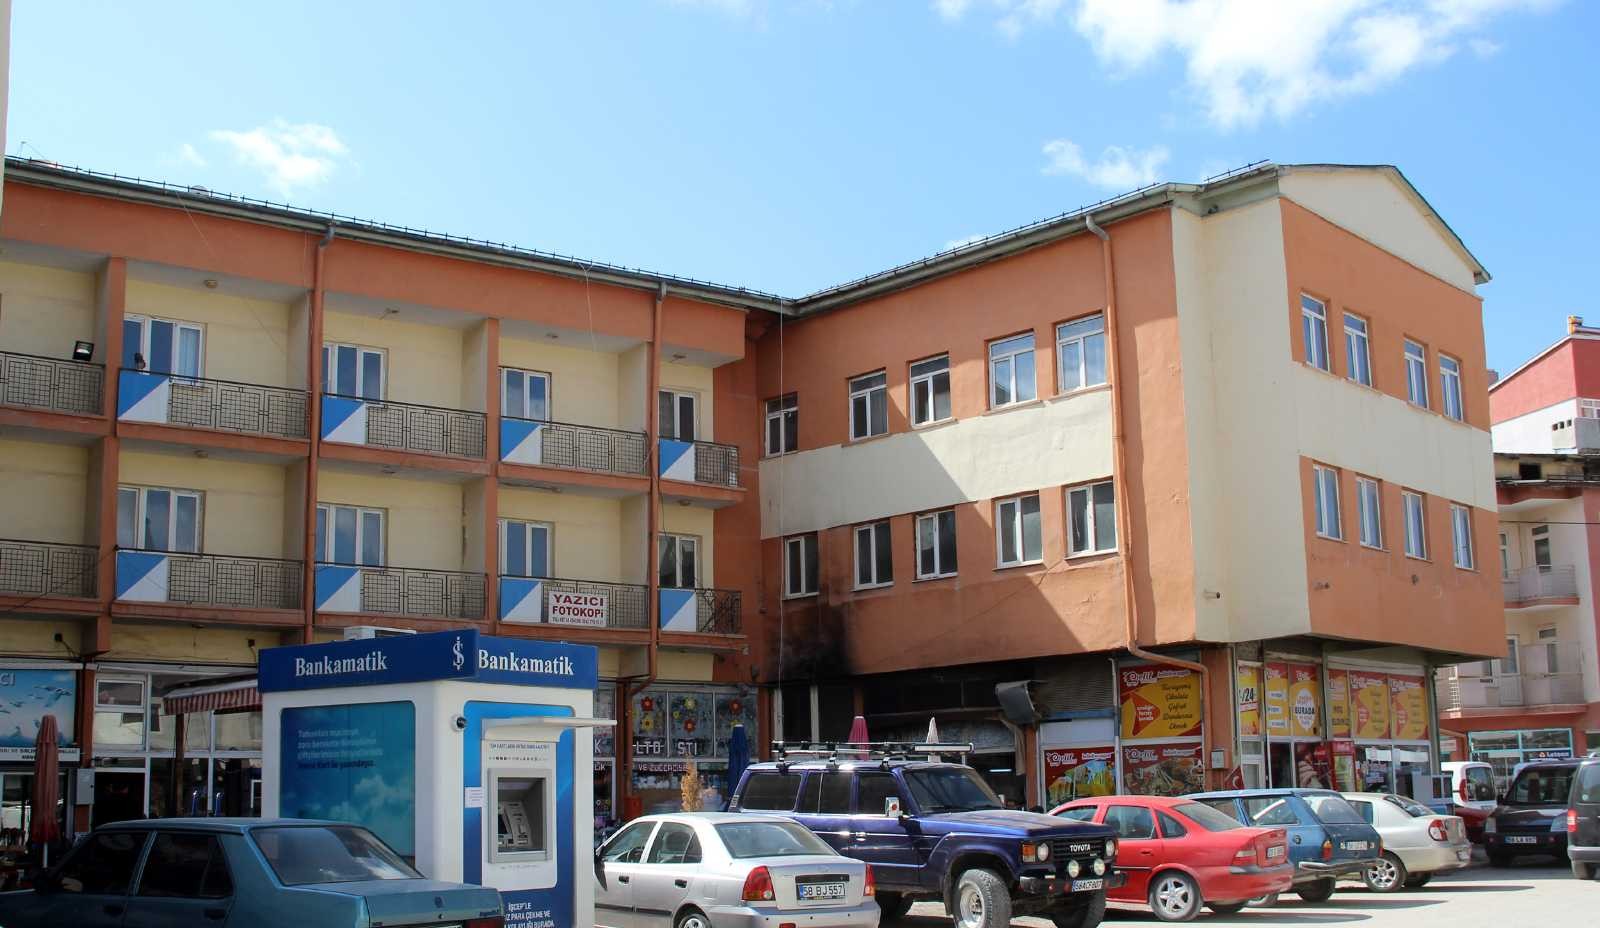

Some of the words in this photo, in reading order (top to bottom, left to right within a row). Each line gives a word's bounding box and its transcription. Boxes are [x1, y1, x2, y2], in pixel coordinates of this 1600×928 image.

[553, 594, 603, 606] YAZICI
[295, 650, 388, 677] Bankamatik
[478, 649, 574, 676] Bankamatik
[1070, 844, 1091, 852] TOYOTA
